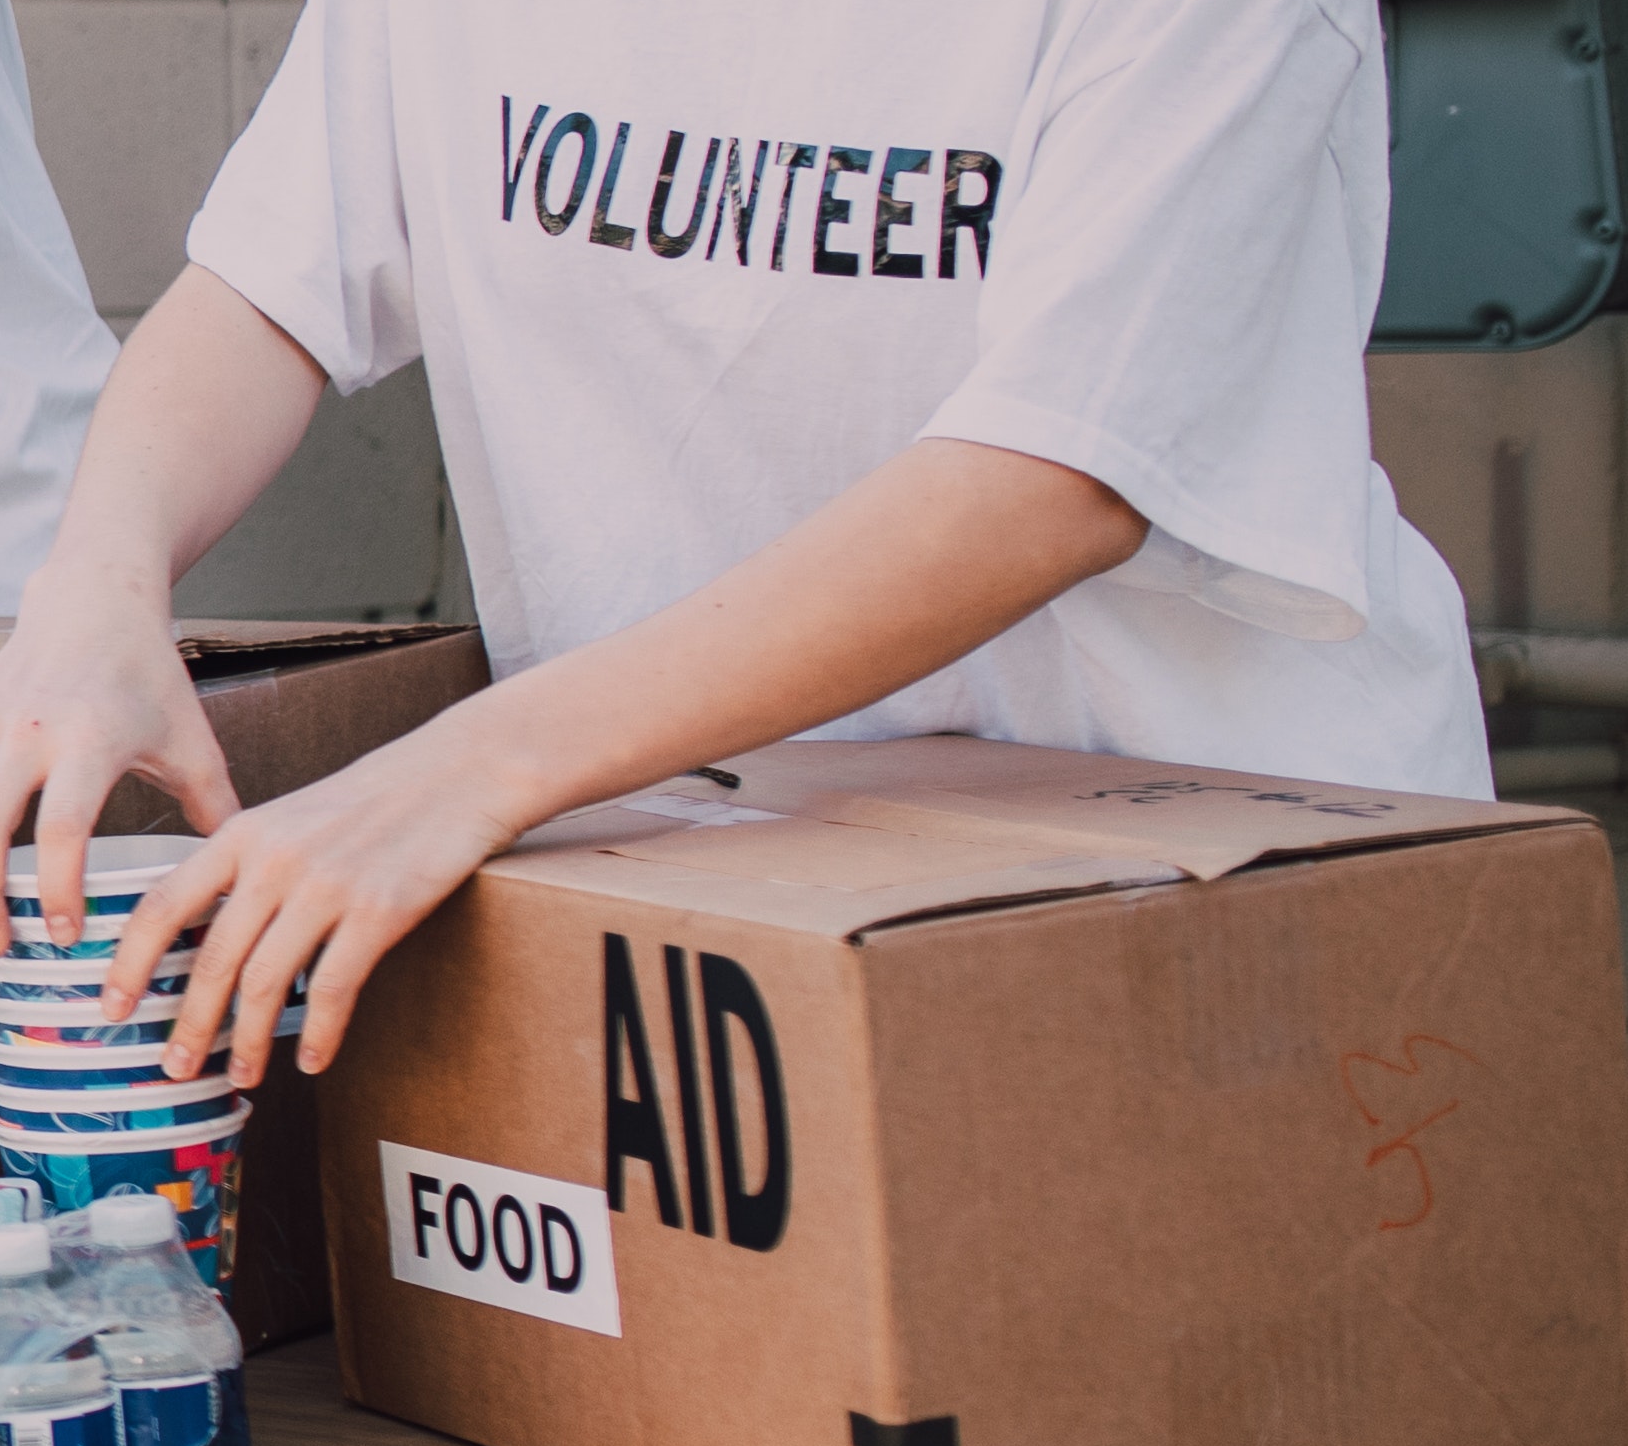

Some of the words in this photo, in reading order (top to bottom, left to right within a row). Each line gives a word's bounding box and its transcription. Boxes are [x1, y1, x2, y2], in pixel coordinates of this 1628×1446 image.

[501, 94, 1004, 281] VOLUNTEER
[602, 930, 794, 1254] AID
[408, 1171, 585, 1295] FOOD
